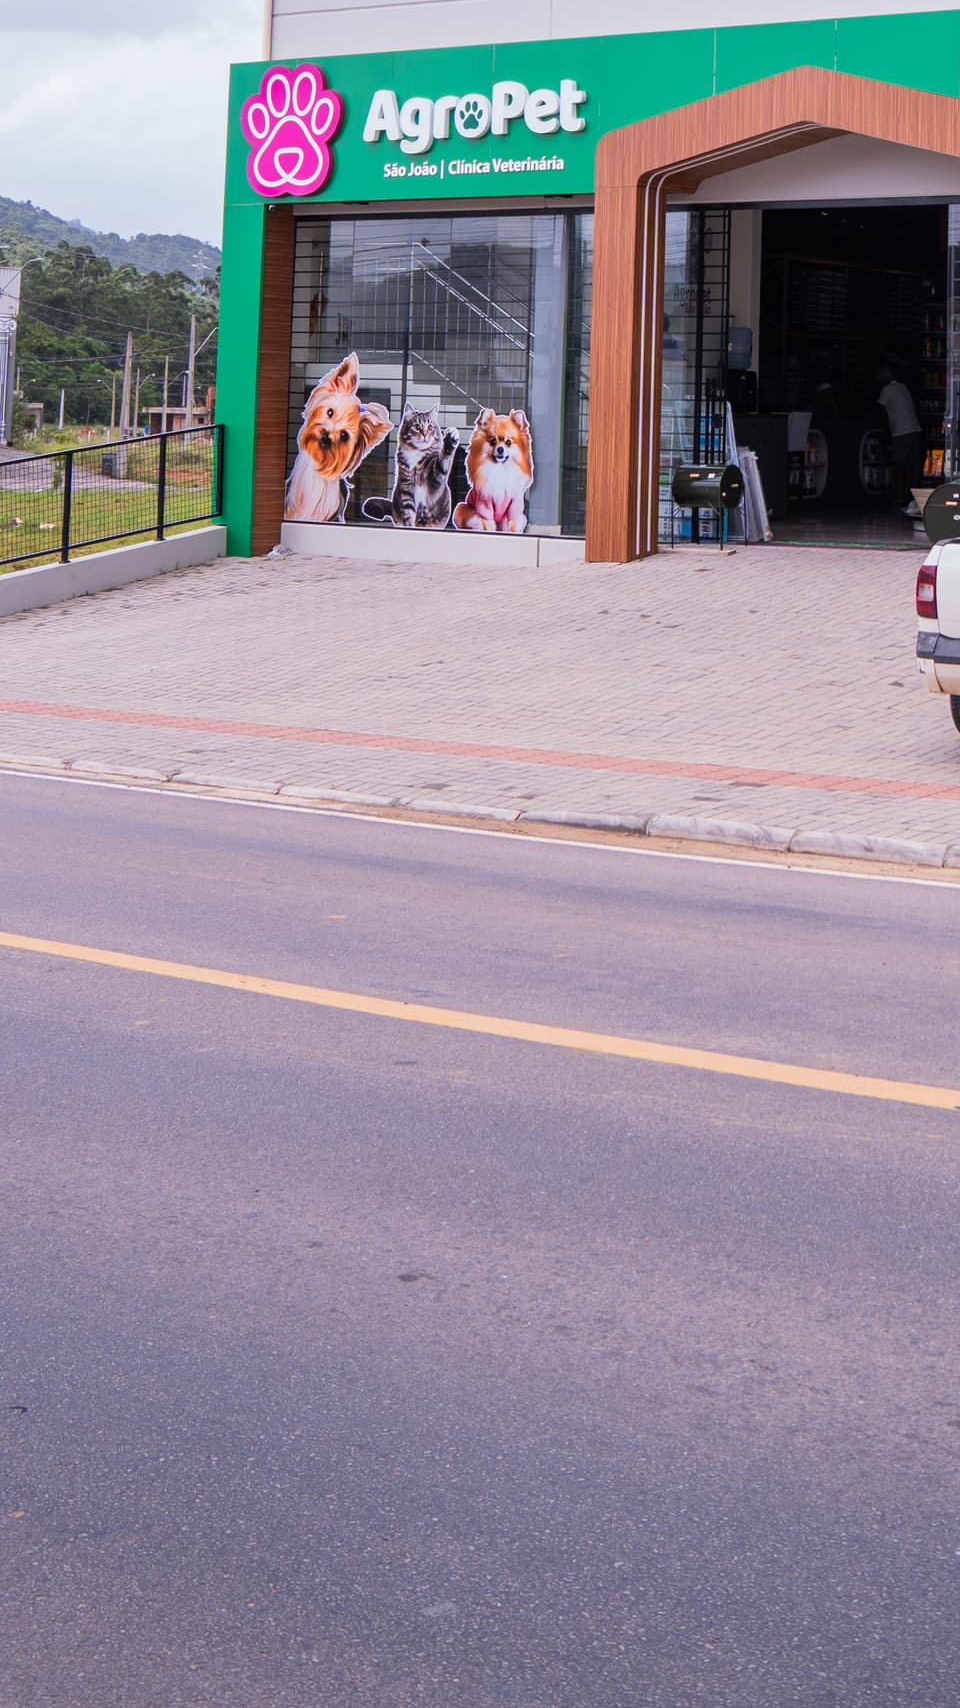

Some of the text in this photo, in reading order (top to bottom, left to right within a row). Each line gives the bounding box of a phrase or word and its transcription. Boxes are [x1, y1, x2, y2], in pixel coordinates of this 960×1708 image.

[363, 79, 587, 154] AgroPet
[384, 161, 406, 178] São
[408, 160, 437, 177] João
[448, 159, 490, 175] Clínica
[492, 156, 564, 172] Veterinária
